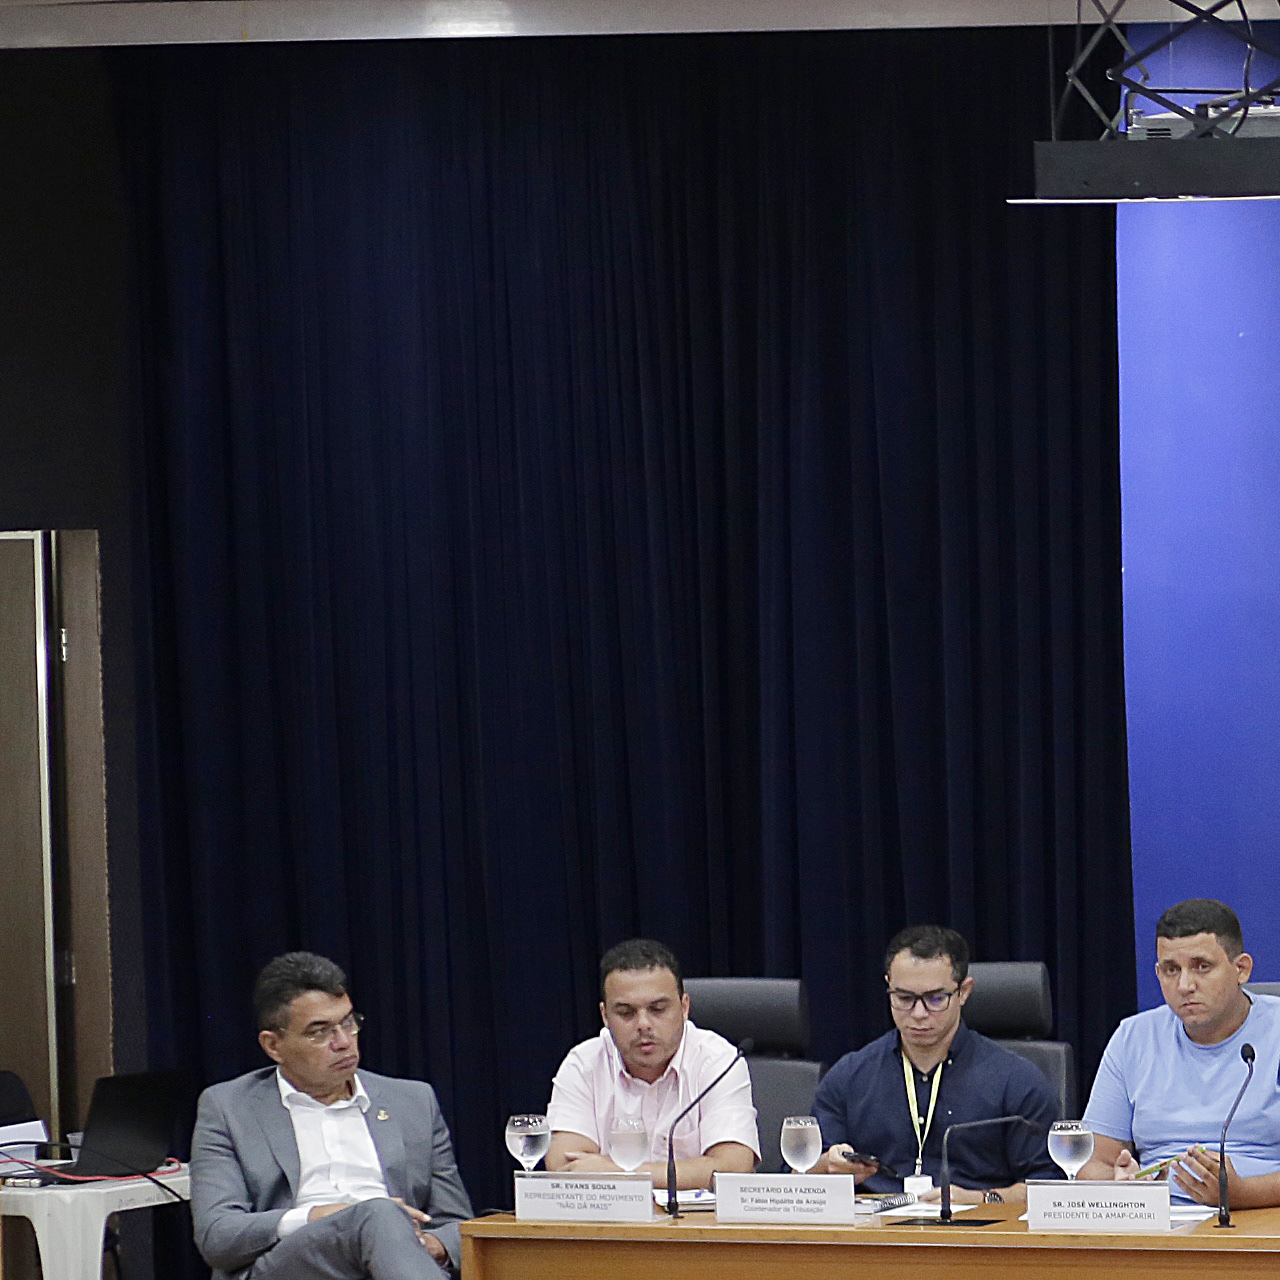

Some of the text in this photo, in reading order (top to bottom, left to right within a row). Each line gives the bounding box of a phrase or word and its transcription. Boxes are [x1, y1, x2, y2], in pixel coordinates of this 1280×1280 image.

[524, 1192, 583, 1200] REPRESENTANTE
[599, 1194, 644, 1202] MOVIMENTO
[1067, 1200, 1085, 1208] JOSÉ
[1106, 1212, 1155, 1220] AMAP-CARIRI
